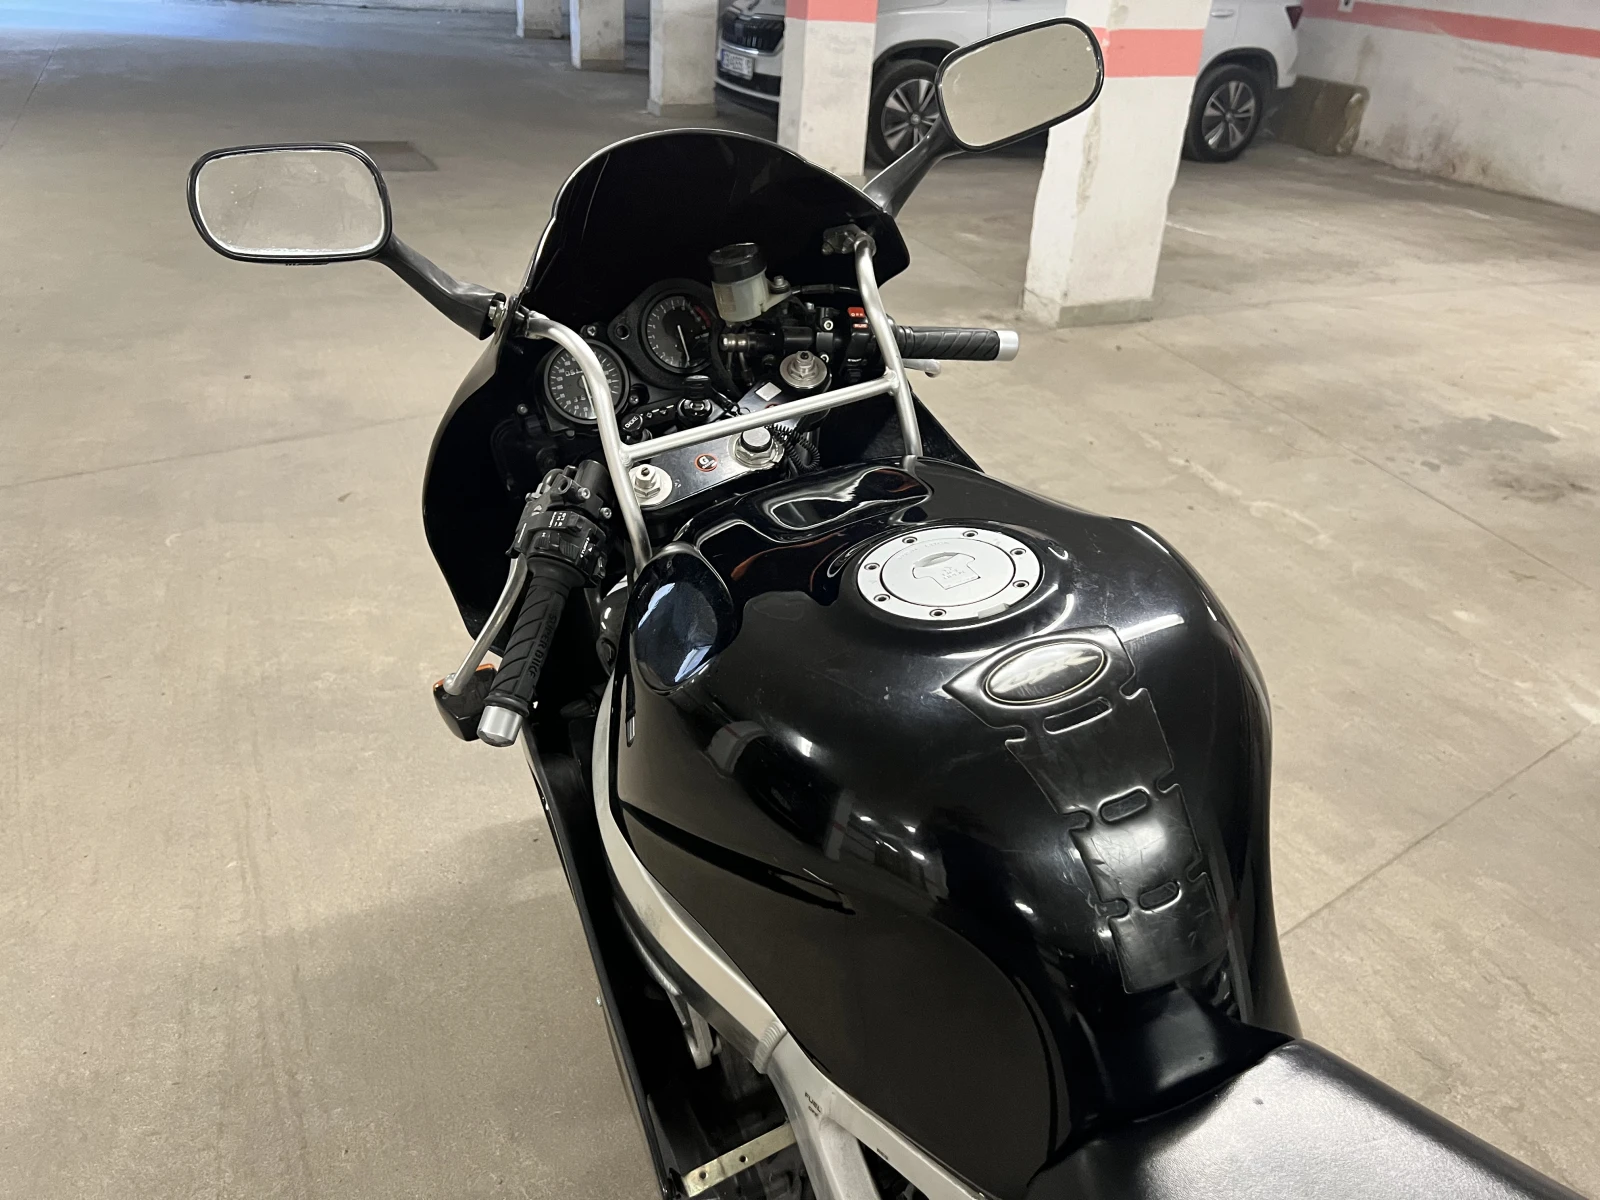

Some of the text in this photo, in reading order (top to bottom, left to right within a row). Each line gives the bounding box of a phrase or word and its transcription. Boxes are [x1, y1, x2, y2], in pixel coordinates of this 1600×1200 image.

[528, 613, 558, 679] SUPER BIKE
[804, 1091, 821, 1113] FUEL
